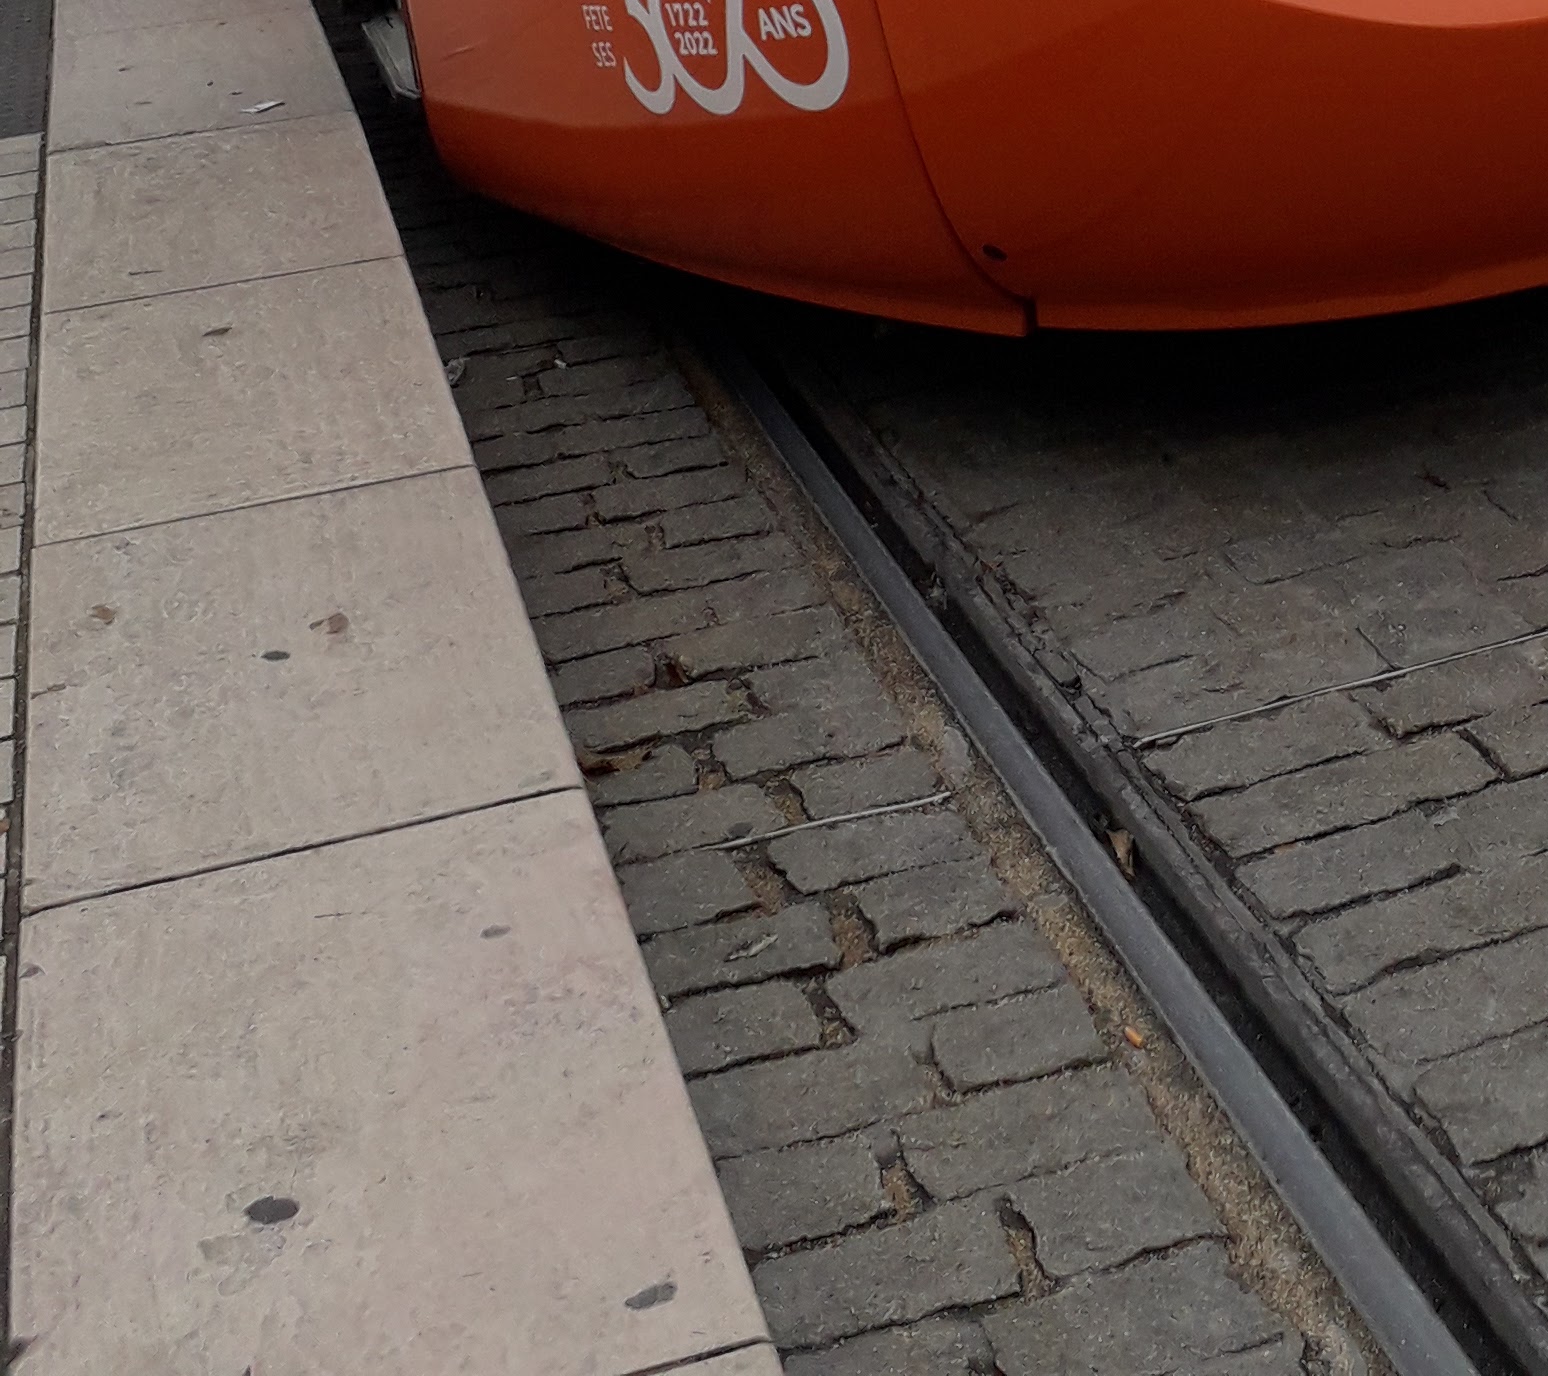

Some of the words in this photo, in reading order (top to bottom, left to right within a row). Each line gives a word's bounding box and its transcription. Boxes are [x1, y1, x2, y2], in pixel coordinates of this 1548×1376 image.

[663, 1, 710, 27] 1722
[757, 3, 812, 43] ANS
[591, 41, 618, 68] SES
[673, 30, 719, 57] 2022
